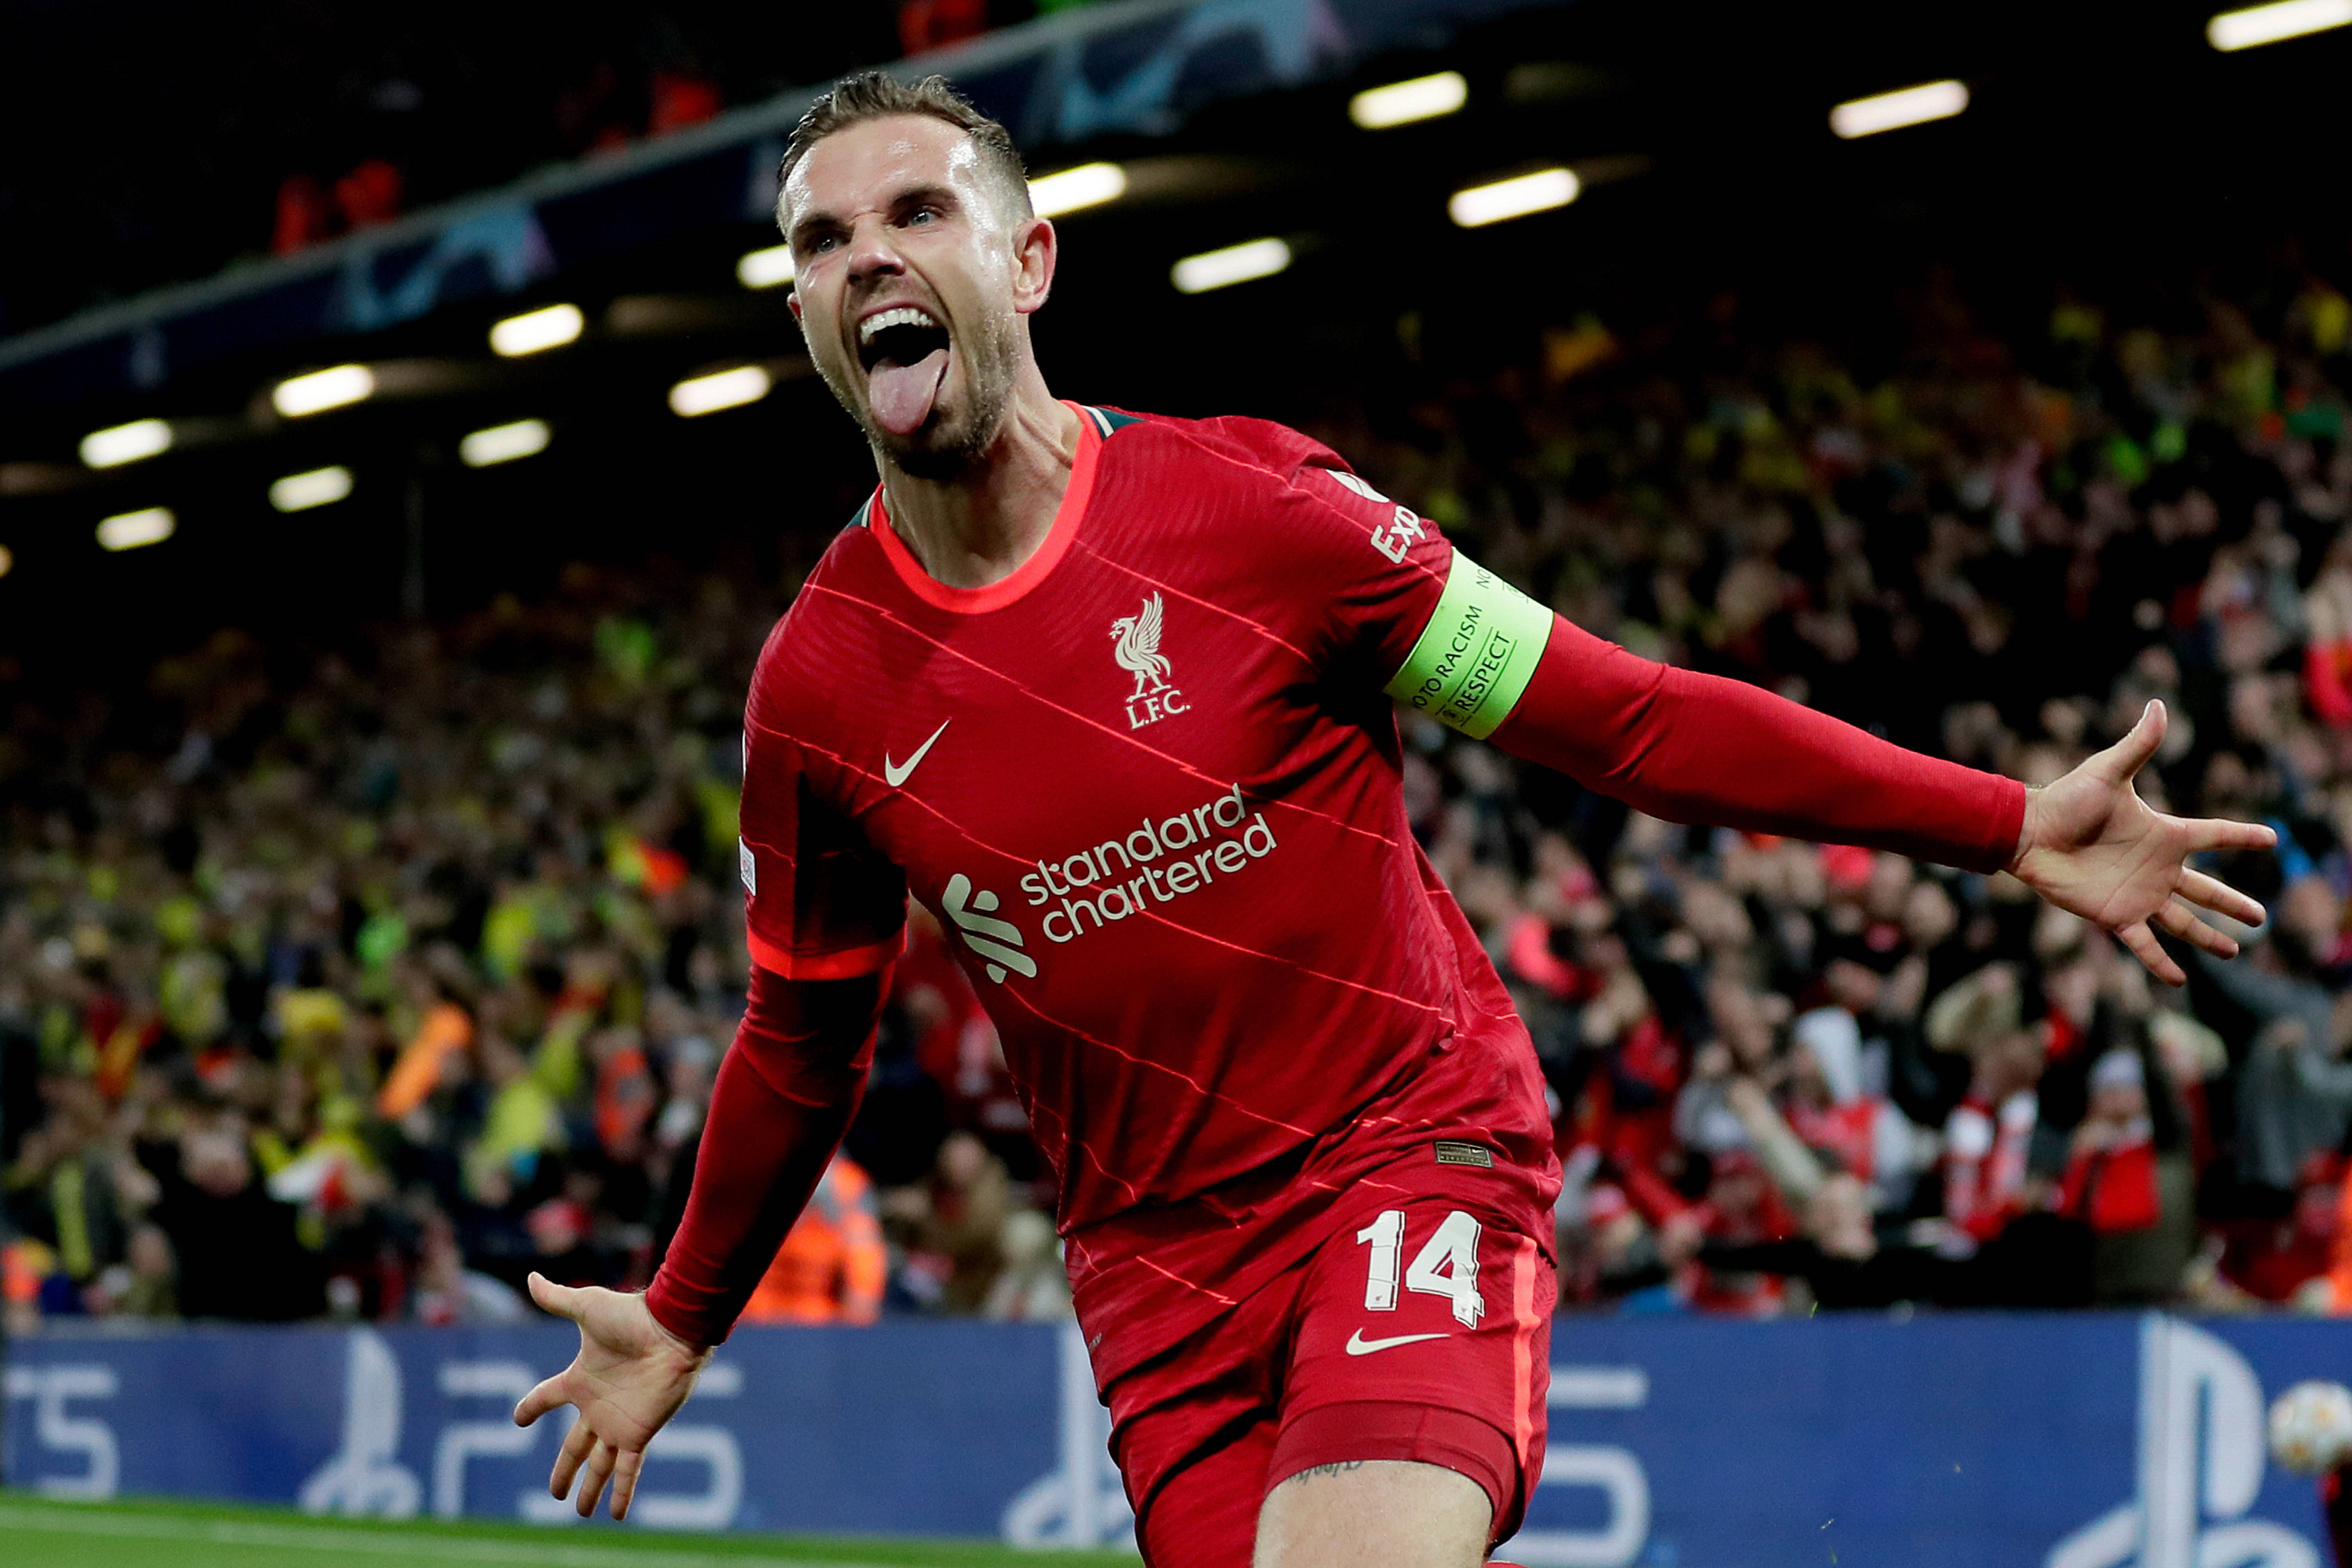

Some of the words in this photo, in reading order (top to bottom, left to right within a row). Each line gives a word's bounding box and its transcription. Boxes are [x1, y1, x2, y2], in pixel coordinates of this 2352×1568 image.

[1435, 605, 1483, 678] RACISM
[1454, 630, 1511, 711] RESPECT
[1125, 690, 1191, 729] L.F.C.
[1020, 782, 1246, 906] standard
[1043, 813, 1277, 943] chartered
[1357, 1209, 1485, 1330] 14
